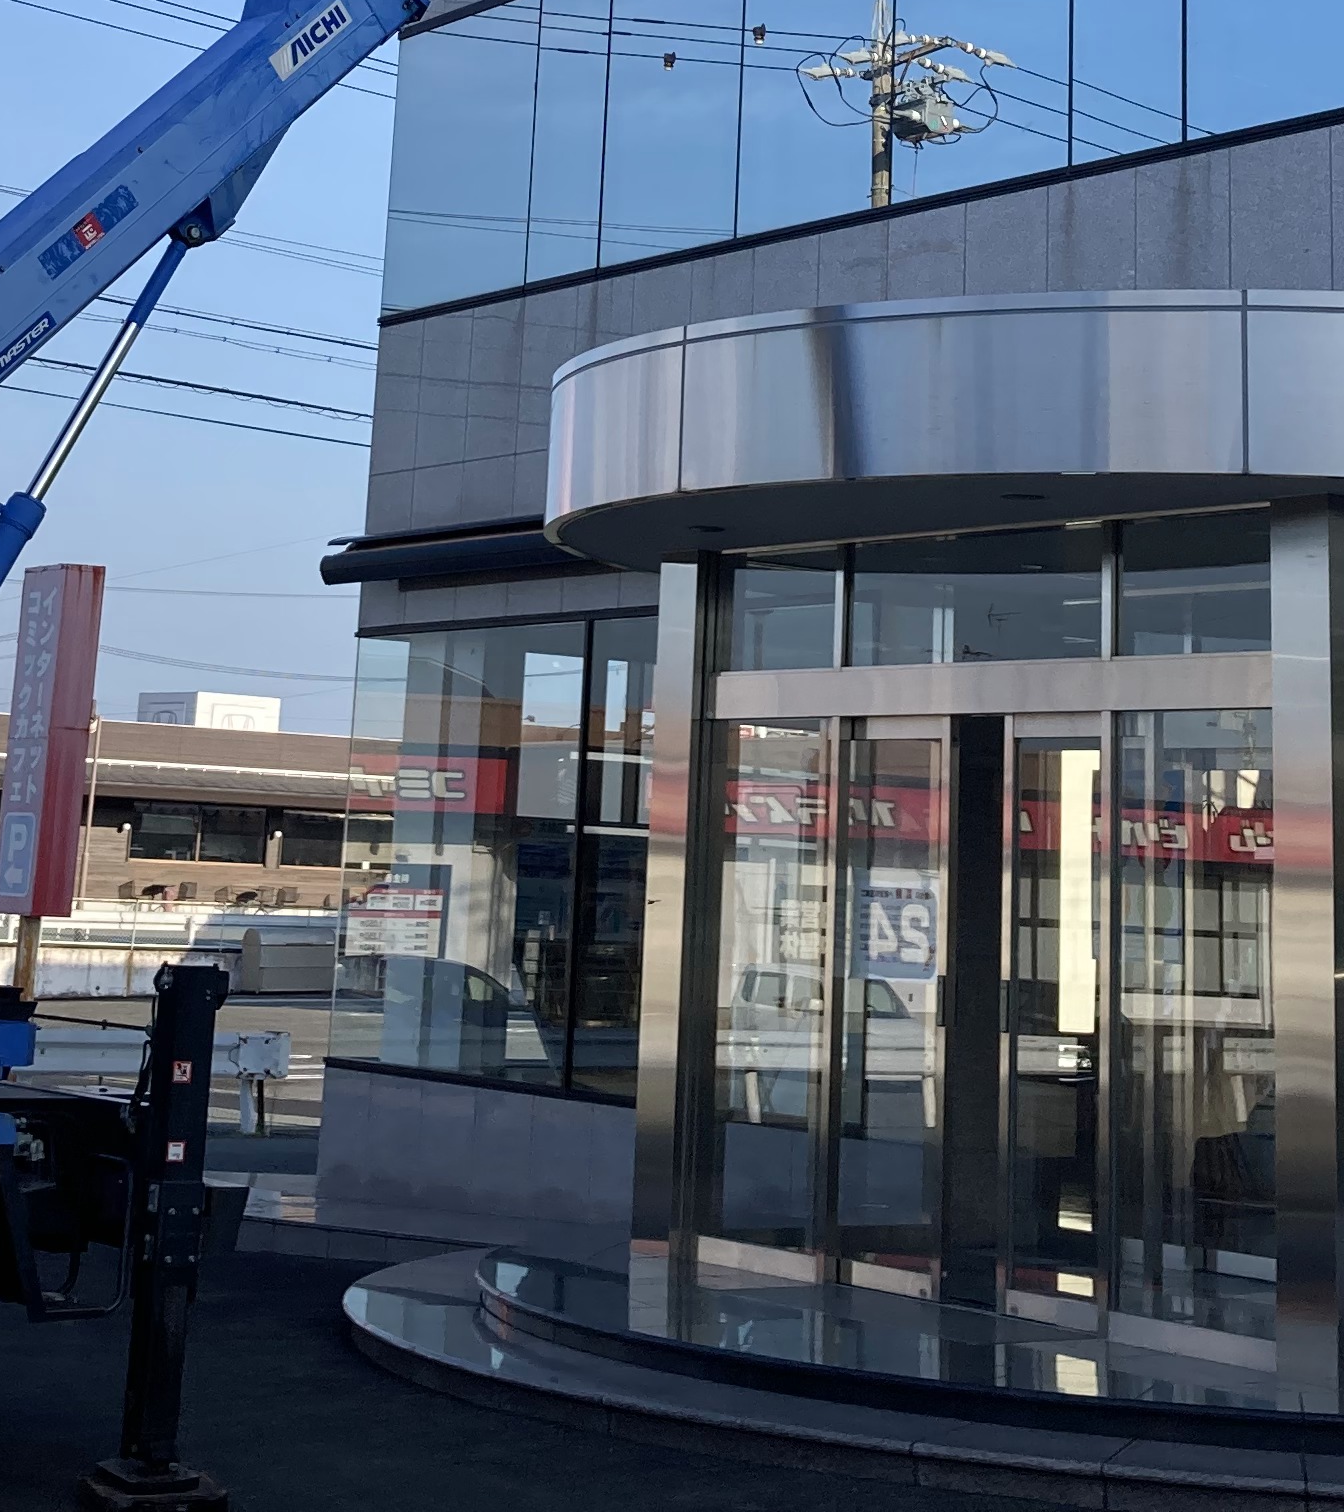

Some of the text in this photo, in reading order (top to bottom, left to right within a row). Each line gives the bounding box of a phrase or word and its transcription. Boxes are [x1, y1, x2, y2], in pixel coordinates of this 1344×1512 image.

[289, 4, 347, 67] AICHI
[9, 590, 42, 803] コミックカフェ
[25, 585, 58, 805] インターネット
[8, 822, 28, 862] P
